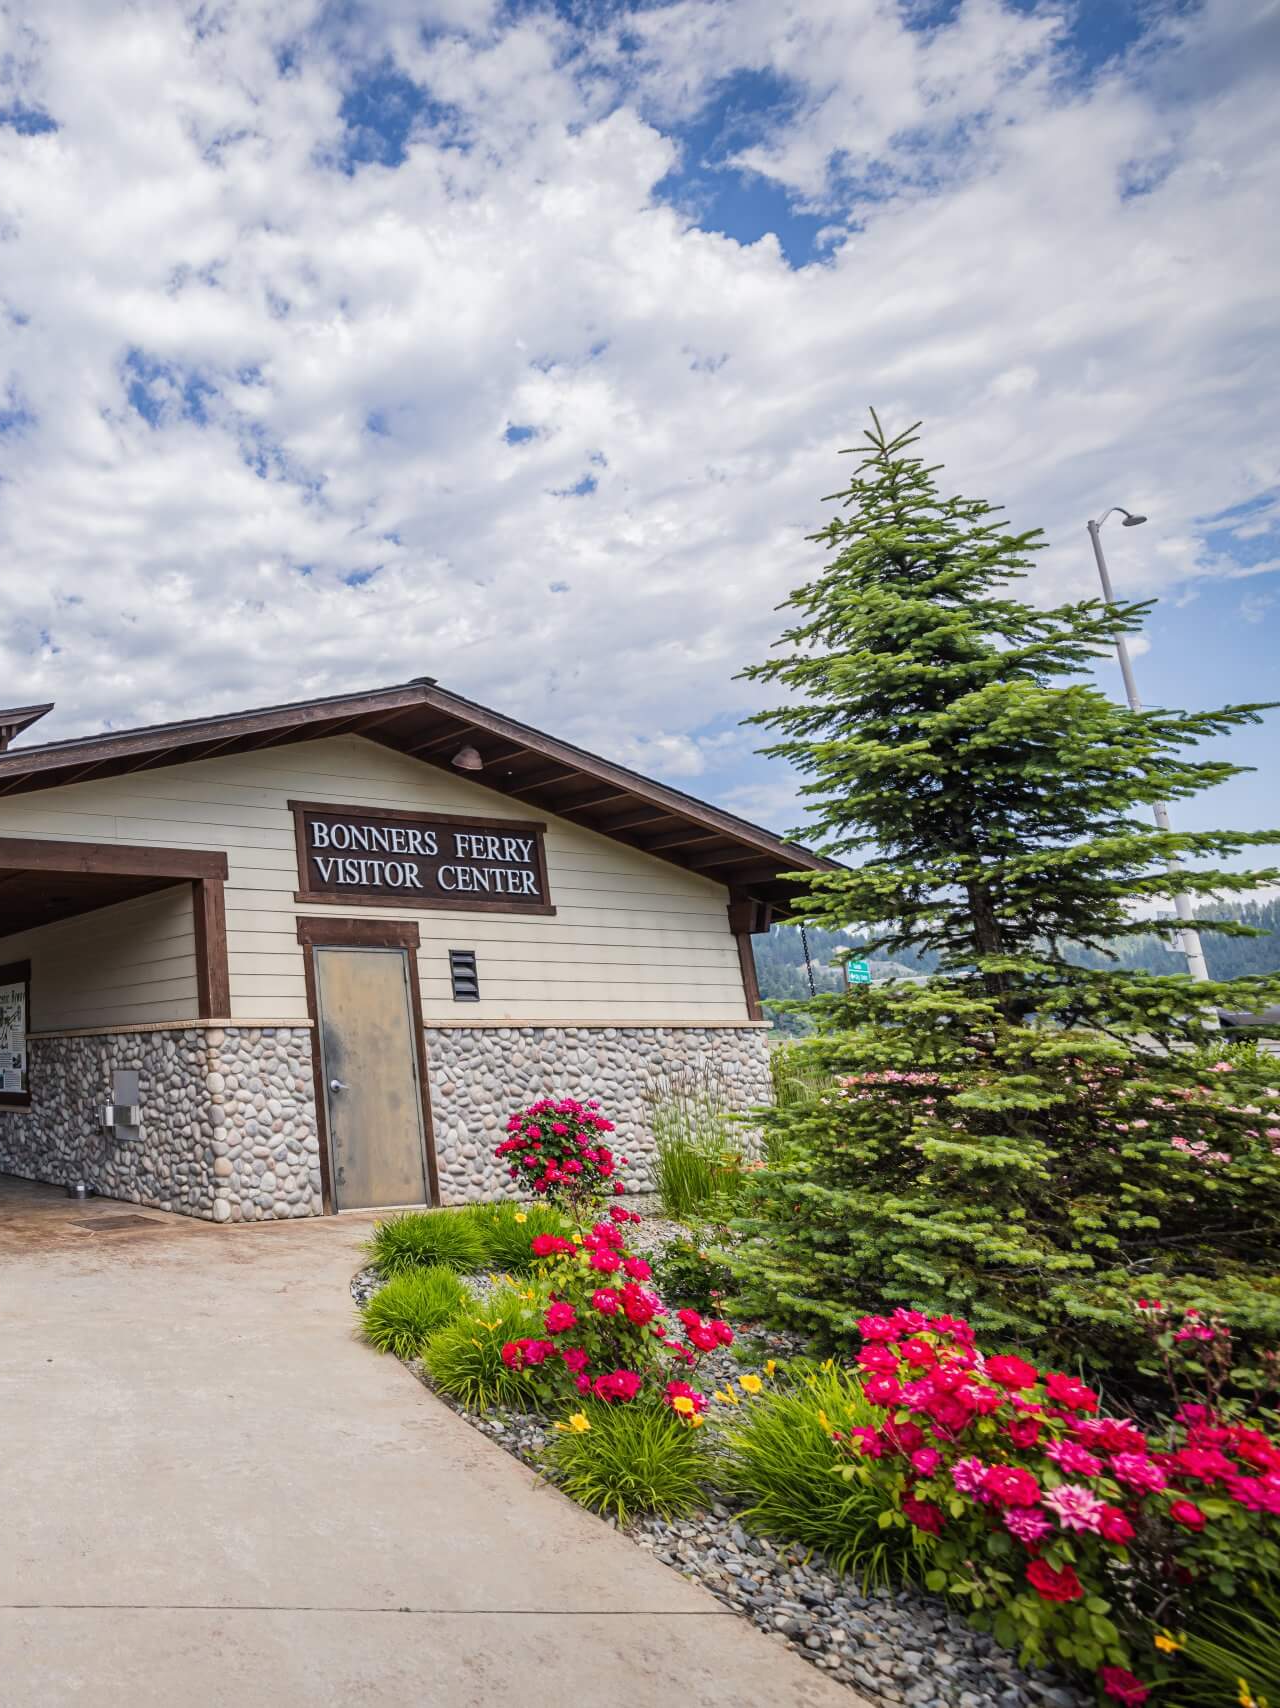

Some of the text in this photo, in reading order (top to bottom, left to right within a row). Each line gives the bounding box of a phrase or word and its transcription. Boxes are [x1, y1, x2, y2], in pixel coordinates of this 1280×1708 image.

[311, 822, 534, 863] BONNERS FERRY
[313, 857, 539, 895] VISITOR CENTER
